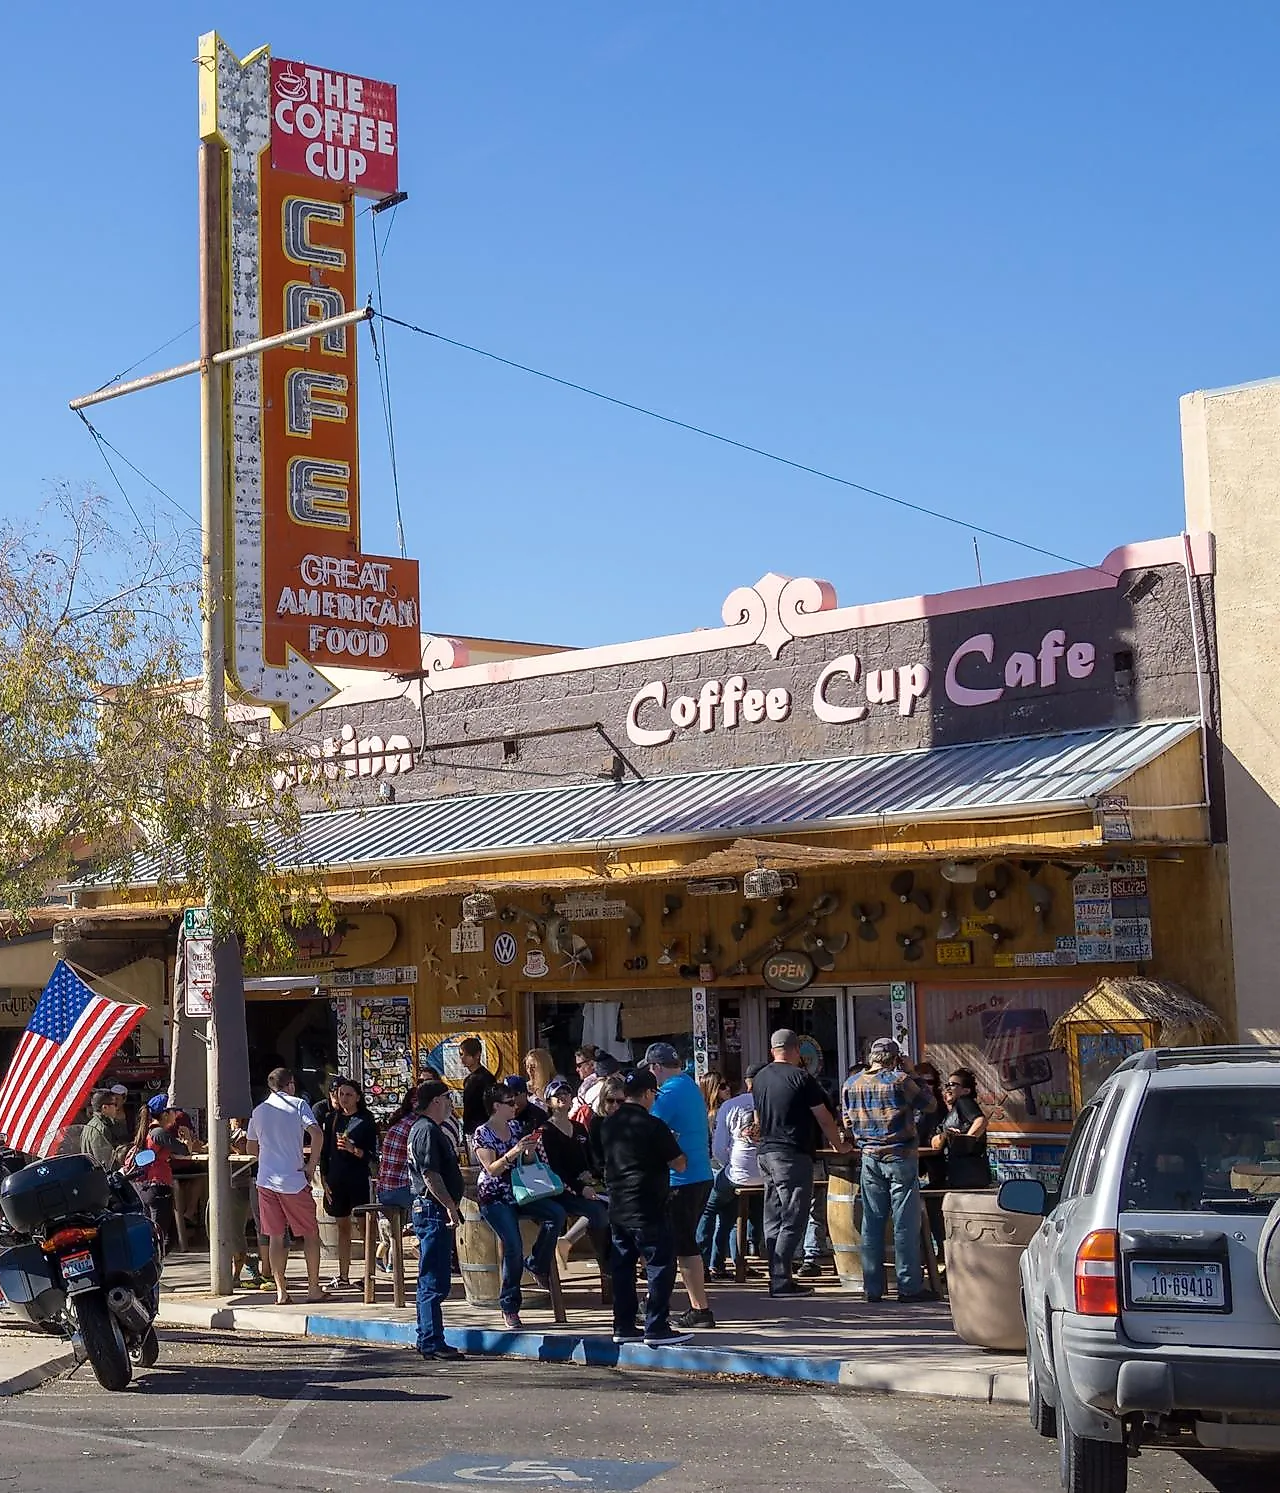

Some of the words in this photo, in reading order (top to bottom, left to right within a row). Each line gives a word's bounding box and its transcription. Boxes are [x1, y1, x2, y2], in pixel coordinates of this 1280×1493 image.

[304, 67, 364, 113] THE
[274, 100, 395, 155] COFFEE
[305, 142, 367, 184] CUP
[282, 195, 351, 531] CAFE
[300, 553, 392, 592] GREAT
[276, 587, 419, 628] AMERICAN
[309, 624, 389, 658] FOOD
[626, 675, 792, 747] Coffee
[813, 652, 931, 725] Cup
[945, 628, 1097, 707] Cafe
[193, 953, 212, 961] OVERS
[195, 963, 212, 971] VEHIC
[769, 964, 806, 977] OPEN
[792, 998, 814, 1010] 512
[389, 1023, 397, 1033] BE
